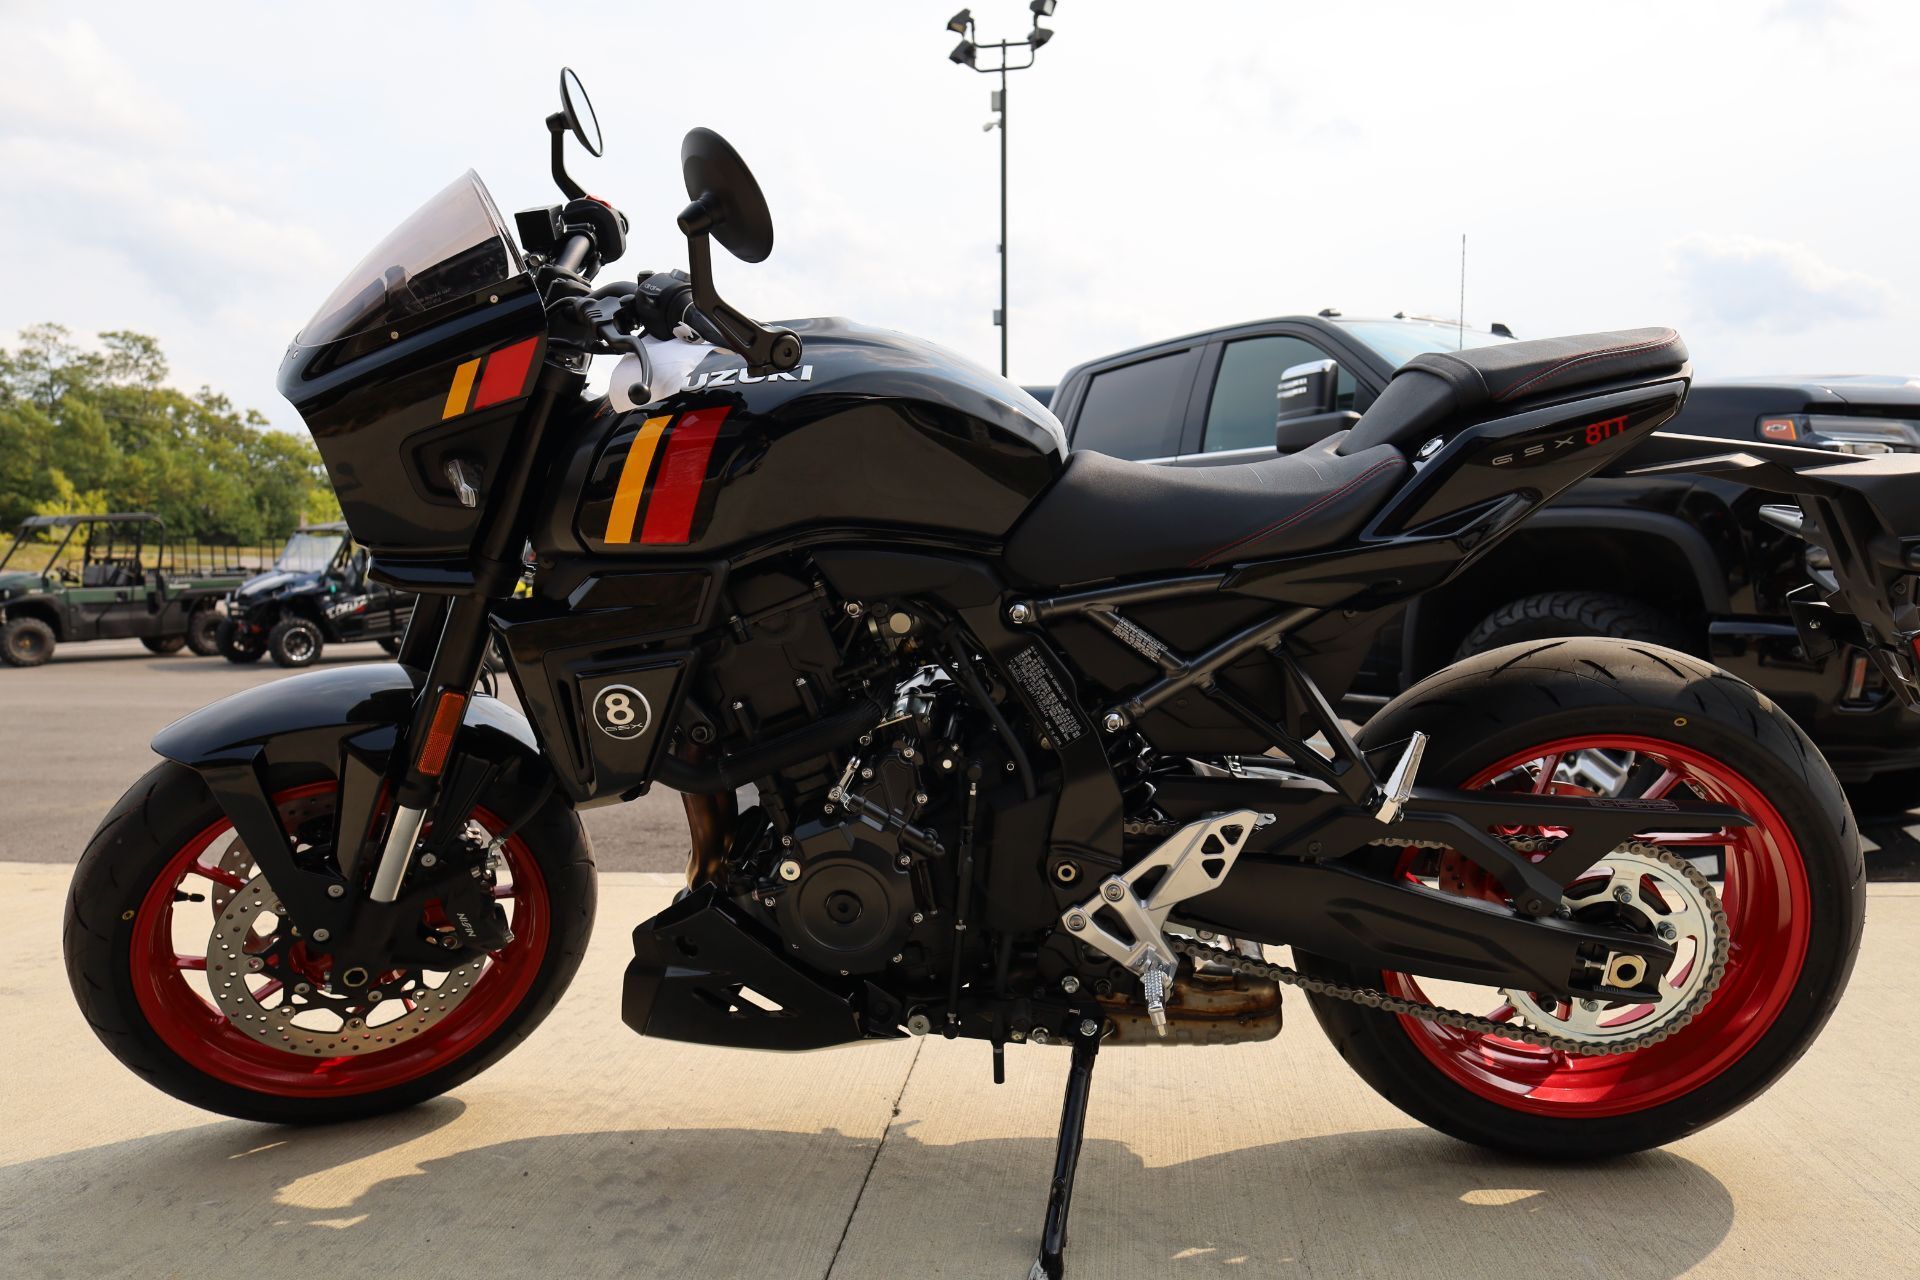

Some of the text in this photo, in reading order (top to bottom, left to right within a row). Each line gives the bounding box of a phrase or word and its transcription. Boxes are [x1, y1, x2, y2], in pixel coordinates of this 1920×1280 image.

[680, 365, 813, 391] UZUKI
[1491, 415, 1629, 466] GSX 8TT
[604, 693, 635, 725] 8
